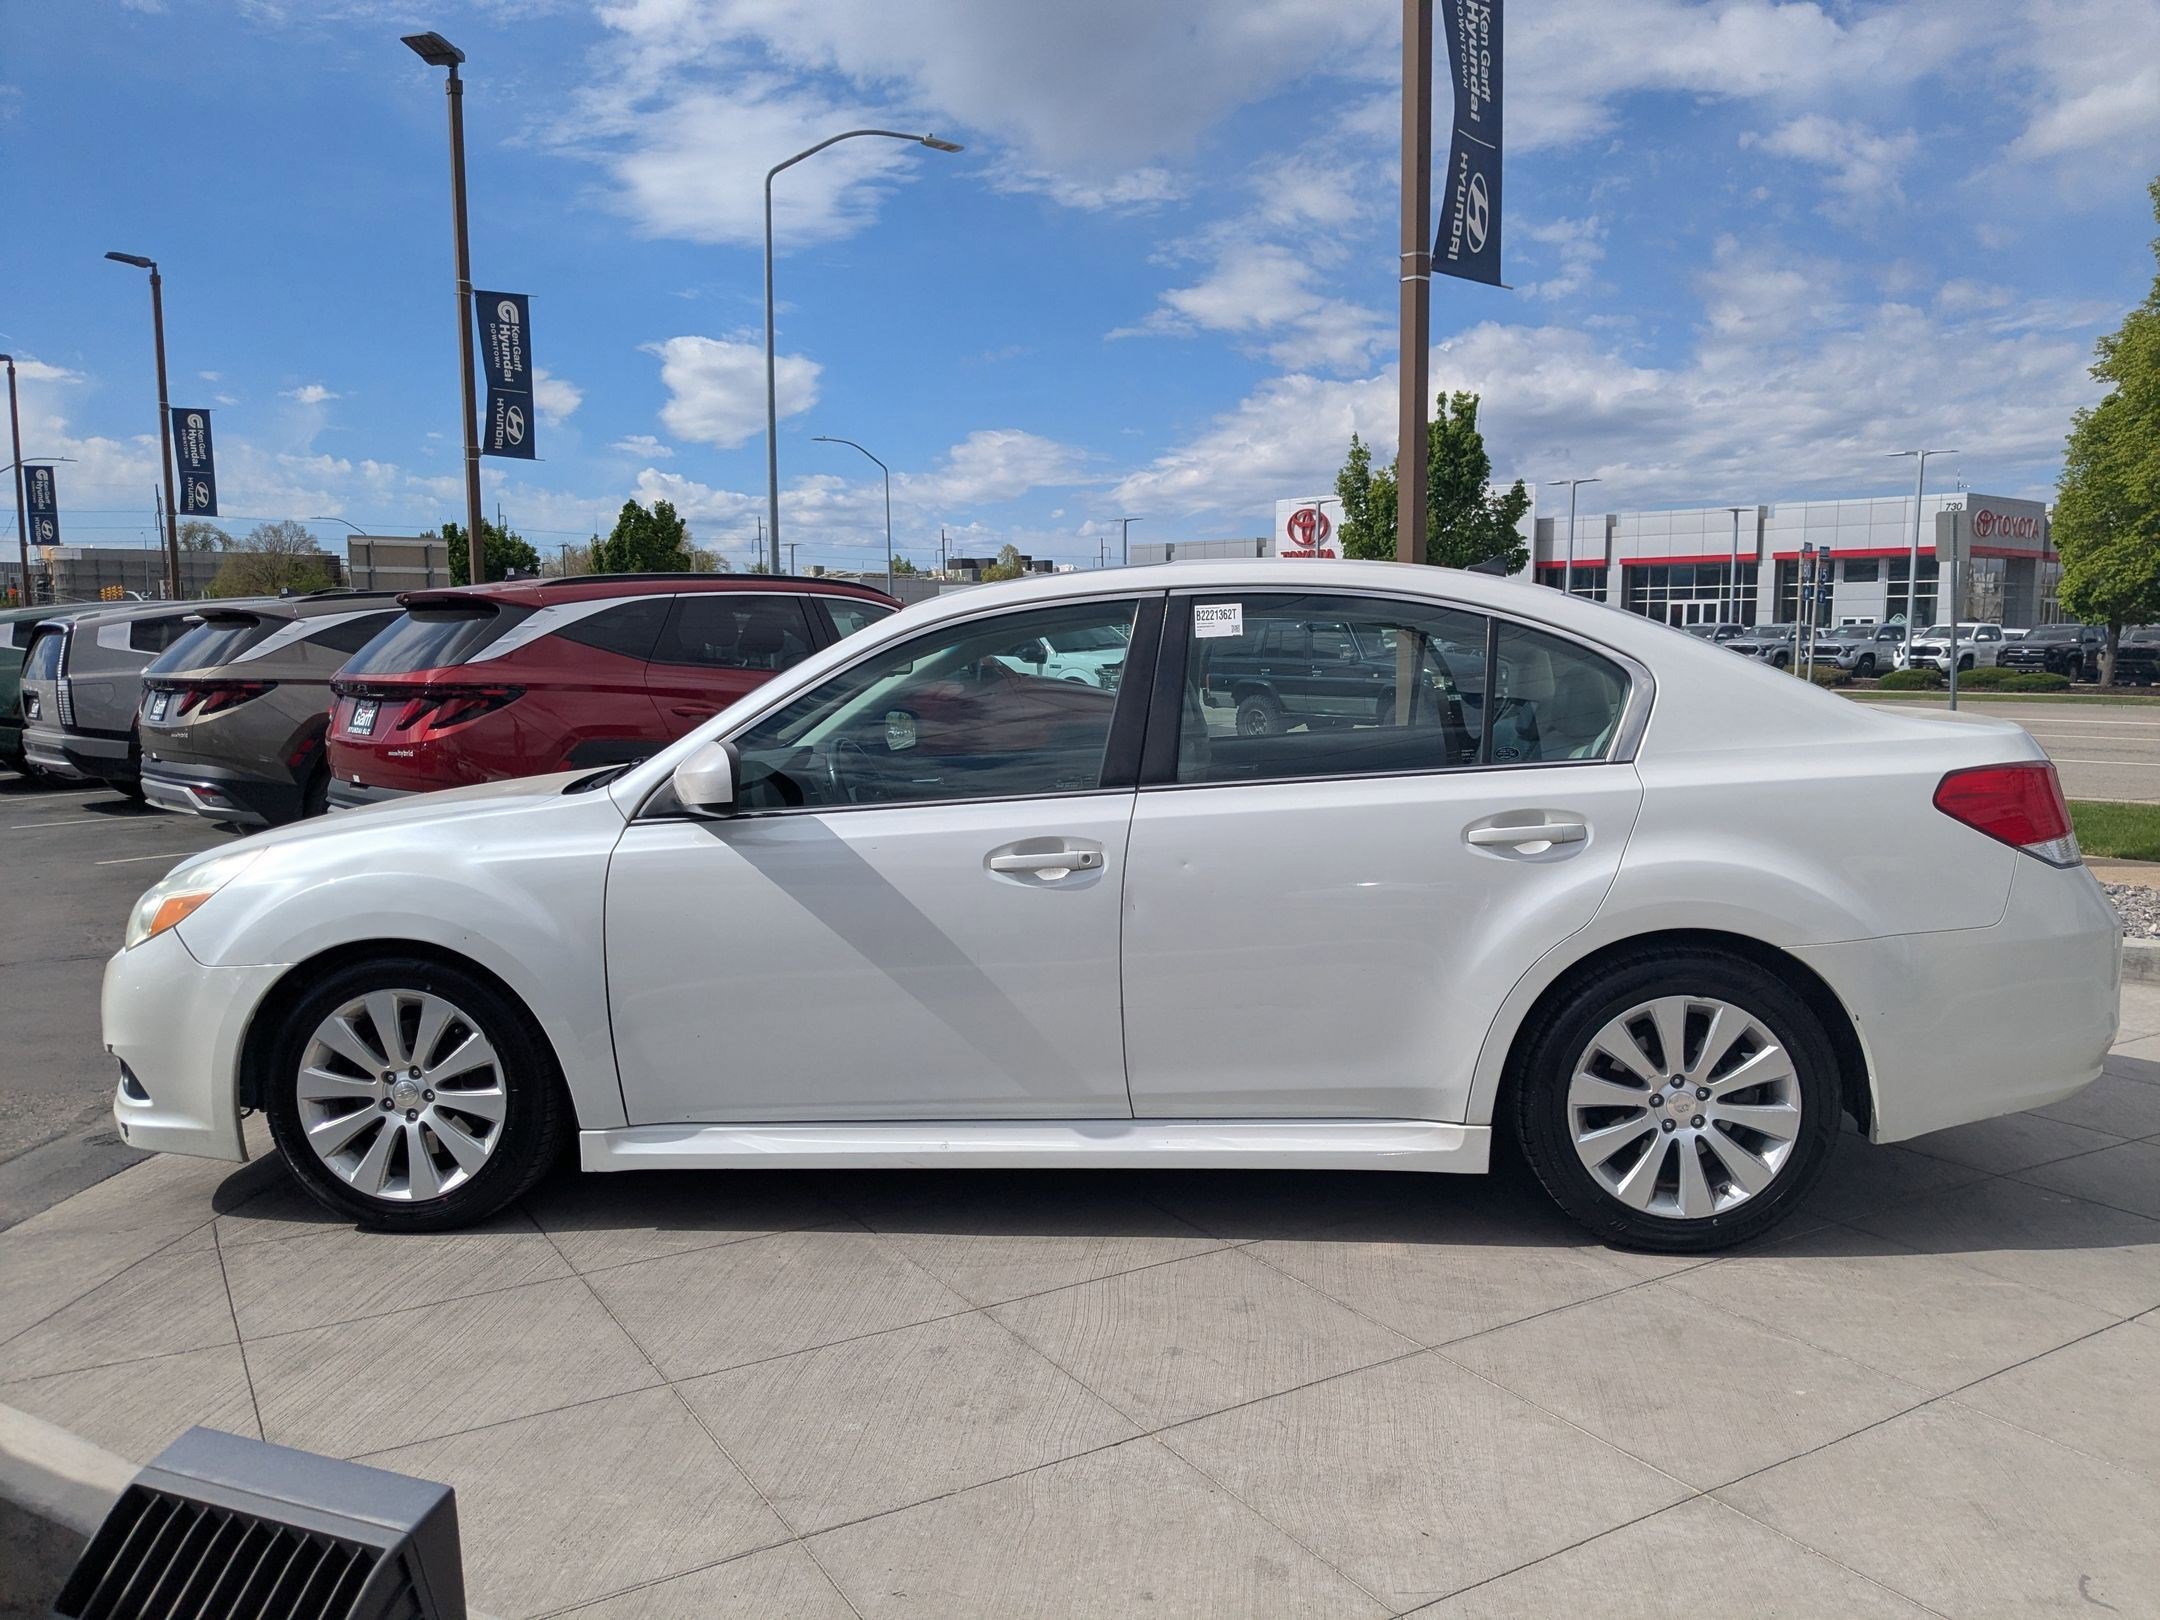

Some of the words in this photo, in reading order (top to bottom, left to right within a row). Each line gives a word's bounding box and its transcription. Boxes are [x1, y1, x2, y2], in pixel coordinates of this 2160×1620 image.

[1480, 5, 1490, 46] Ken
[1466, 0, 1480, 122] Hyundai
[1481, 50, 1491, 103] Garff
[1447, 152, 1468, 260] HYUNDAI
[490, 322, 500, 368] DOWNTOWN
[499, 324, 514, 382] Hyundai
[511, 325, 520, 345] Ken
[513, 346, 522, 371] Garff
[494, 398, 504, 449] HYUNDAI
[187, 429, 200, 467] Hyundai
[199, 443, 207, 460] Garff
[187, 477, 195, 511] HYUNDAI
[1945, 502, 1963, 511] 730
[1993, 513, 2039, 538] TOYOTA
[1196, 608, 1237, 621] B2221362T
[353, 708, 375, 727] Garff
